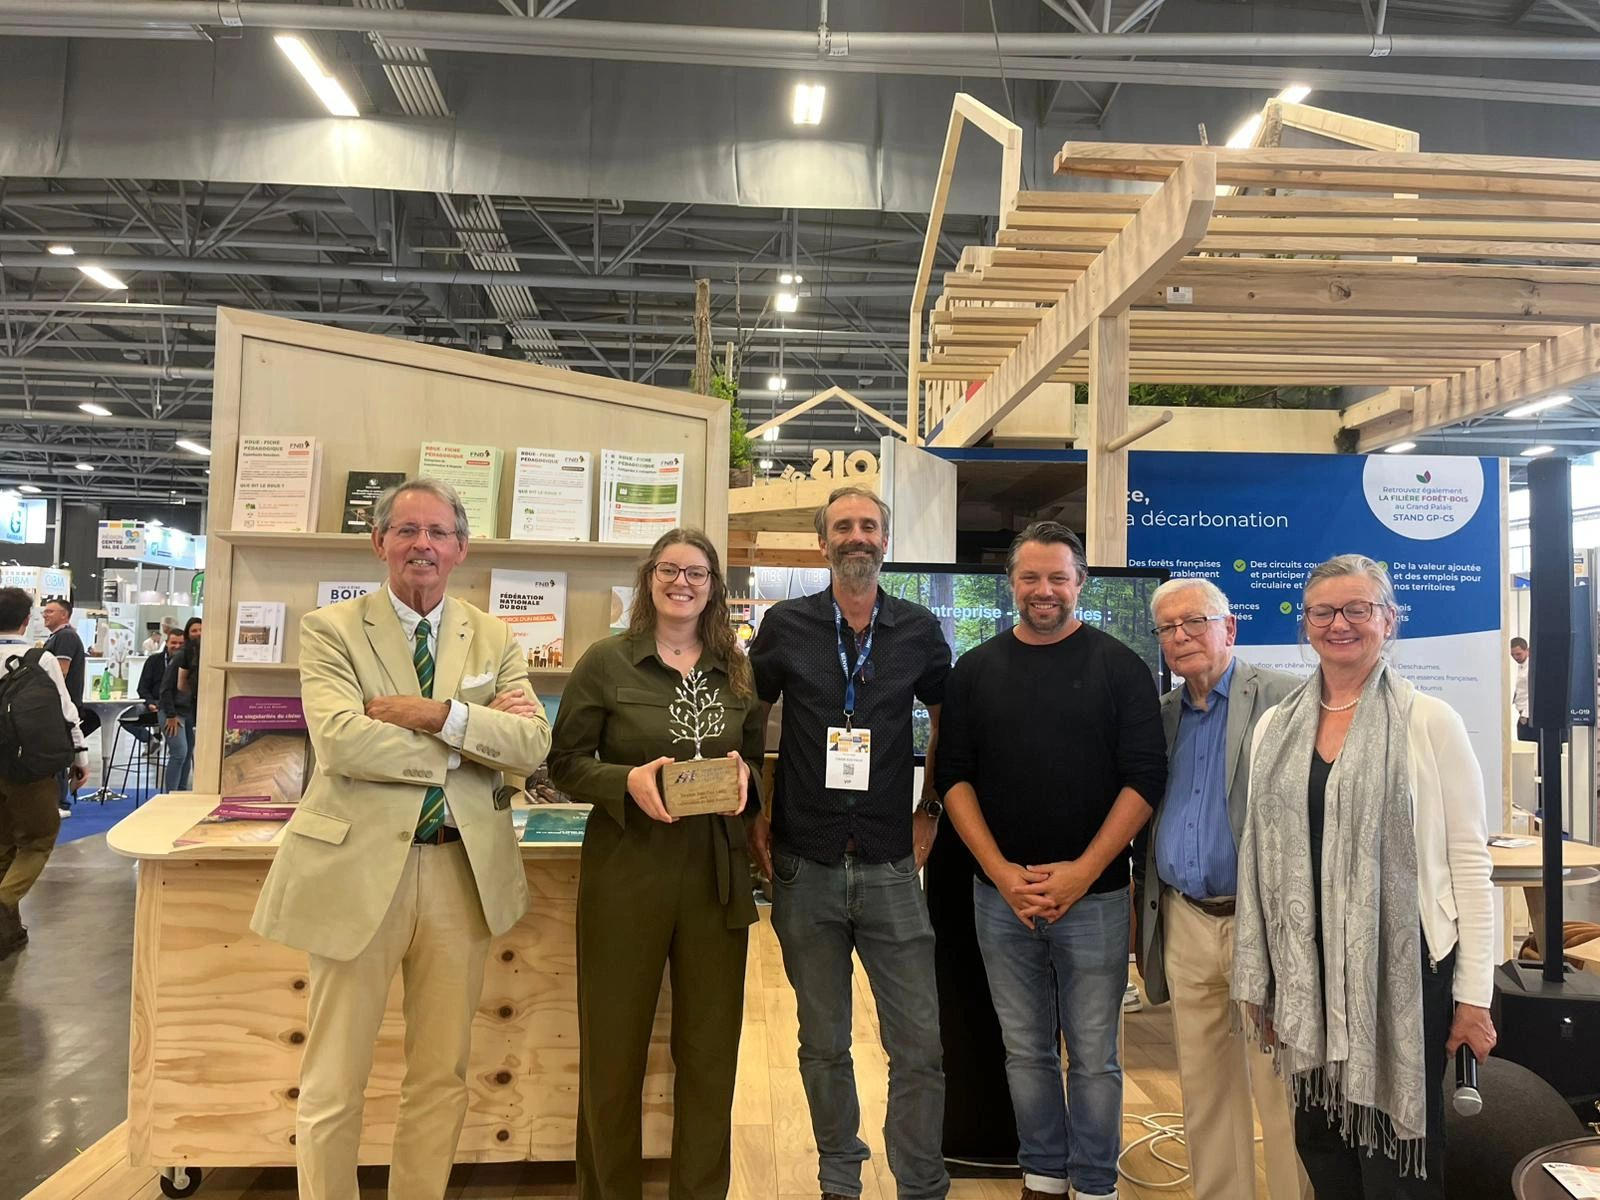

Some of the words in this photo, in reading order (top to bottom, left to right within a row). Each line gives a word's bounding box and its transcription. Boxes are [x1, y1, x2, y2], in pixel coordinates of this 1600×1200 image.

[1127, 490, 1150, 505] e,
[1422, 494, 1468, 502] FORÊT-BOIS
[1127, 514, 1134, 526] a
[1142, 510, 1288, 527] décarbonation
[1148, 559, 1174, 567] forêts
[1176, 560, 1221, 569] françaises
[1393, 562, 1406, 570] De
[1408, 562, 1416, 570] la
[1418, 563, 1445, 571] valeur
[1448, 563, 1481, 572] ajoutée
[1262, 571, 1305, 580] participer
[1423, 573, 1458, 582] emplois
[1460, 575, 1481, 583] pour
[1251, 581, 1292, 589] circulaire
[1412, 583, 1456, 591] territoires
[500, 592, 544, 600] FÉDÉRATION
[1398, 603, 1411, 611] ois
[931, 606, 1001, 621] ntreprise
[1074, 607, 1102, 621] ries
[1235, 612, 1253, 620] iées
